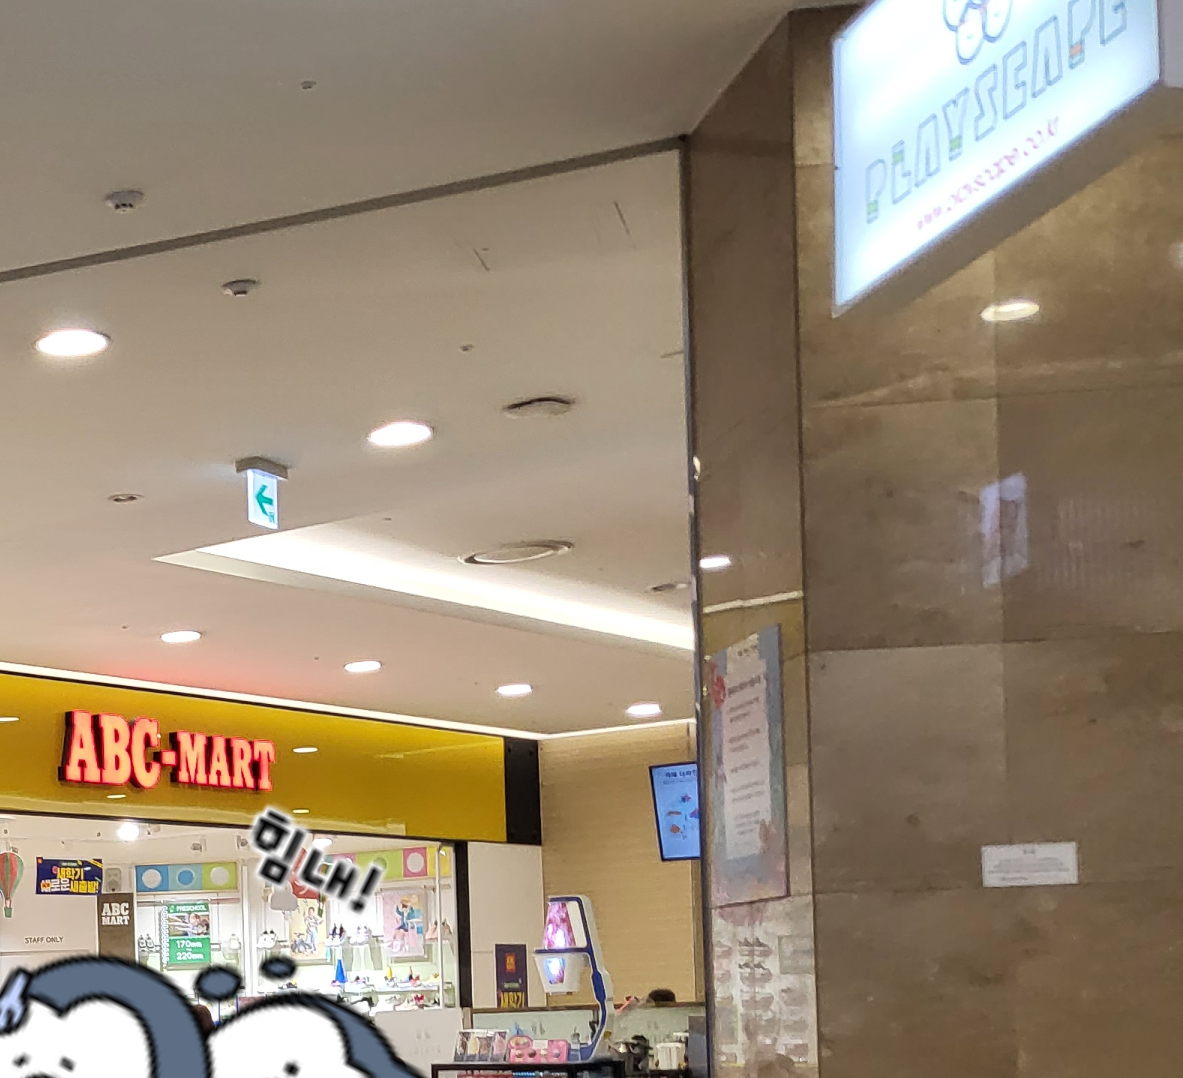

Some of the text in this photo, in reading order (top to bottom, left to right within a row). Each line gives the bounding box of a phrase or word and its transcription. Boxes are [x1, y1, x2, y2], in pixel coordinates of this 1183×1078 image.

[65, 709, 276, 791] ABC-MART
[101, 902, 130, 916] ABC
[101, 915, 130, 926] MART
[24, 936, 45, 944] STAFF
